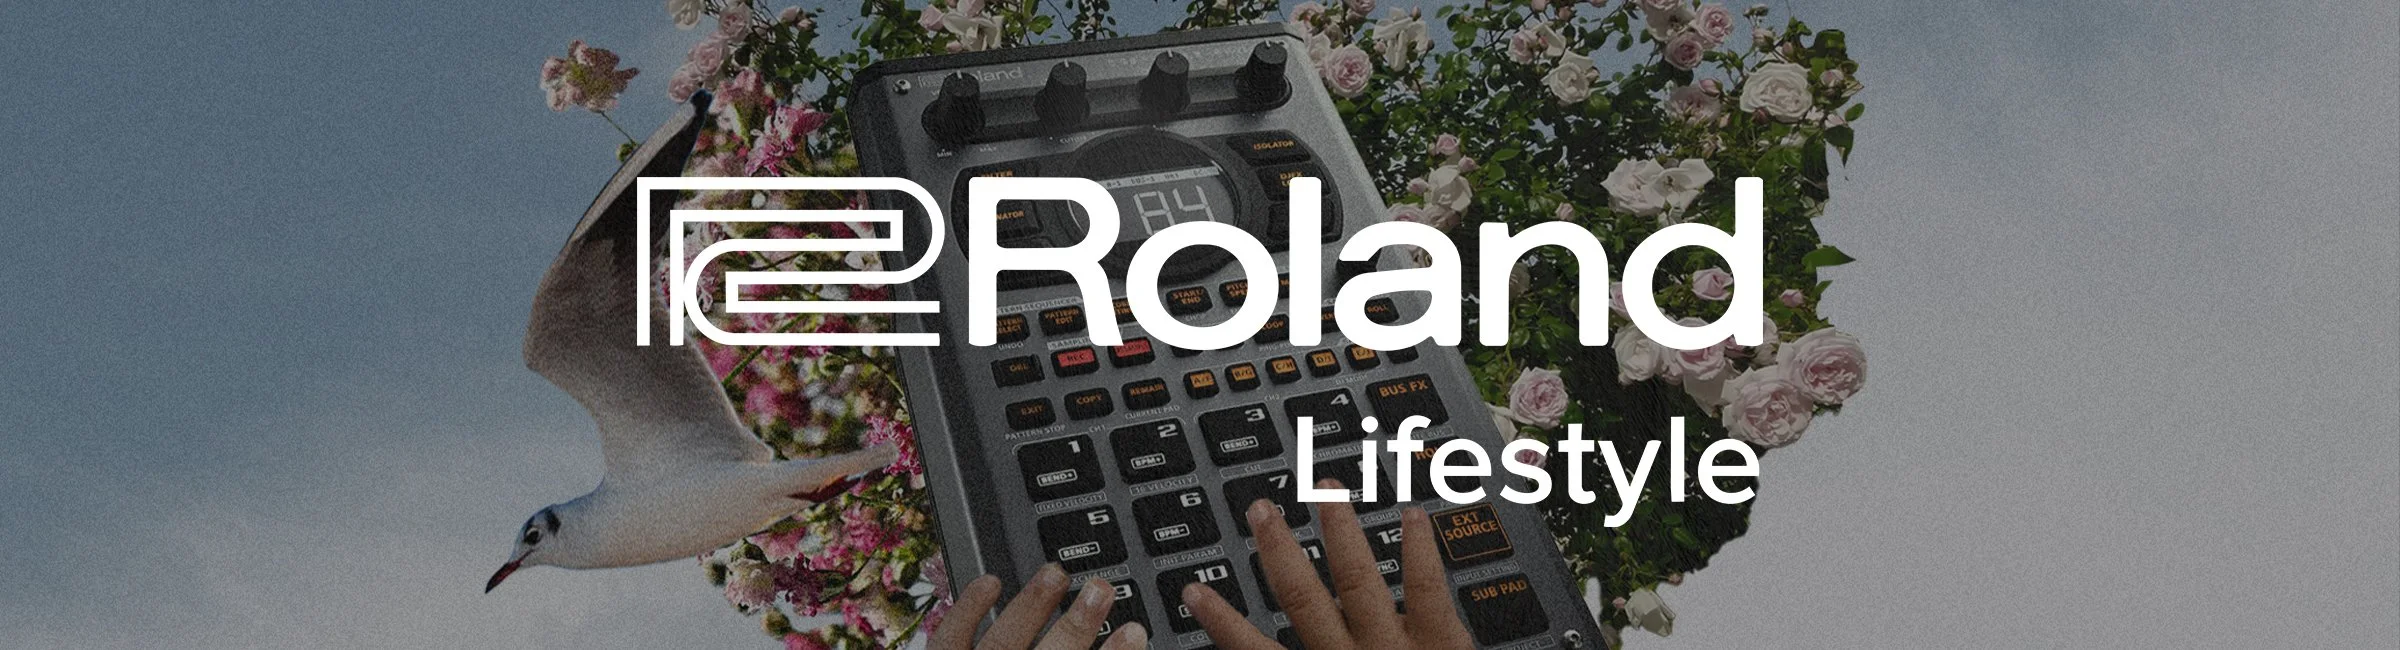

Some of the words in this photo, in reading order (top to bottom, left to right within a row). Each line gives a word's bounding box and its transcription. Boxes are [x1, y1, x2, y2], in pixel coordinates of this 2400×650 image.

[1253, 140, 1294, 150] ISOLATOR
[997, 209, 1025, 221] NATOR
[1181, 297, 1202, 305] END
[998, 341, 1024, 351] UNDO
[1067, 352, 1086, 362] REC
[1130, 383, 1164, 397] REMAIN
[1379, 384, 1407, 398] BUS
[1410, 380, 1429, 392] FX
[1076, 393, 1102, 405] COPY
[1330, 394, 1349, 406] 4
[1020, 404, 1043, 415] EXIT
[1125, 408, 1161, 420] CURRENT
[1163, 404, 1181, 414] PAD
[1245, 408, 1266, 422] 3
[1005, 428, 1043, 441] PATTERN
[1045, 424, 1066, 435] STOP
[1157, 423, 1179, 438] 2
[1068, 440, 1081, 454] 1
[1313, 445, 1360, 459] CHROMATI
[1148, 477, 1194, 491] VELOCITY
[1268, 474, 1288, 489] 7
[1065, 494, 1104, 507] VELOCITY
[1180, 492, 1202, 507] 6
[1087, 509, 1110, 526] 5
[1452, 511, 1479, 526] EXT
[1377, 527, 1403, 545] 12
[1445, 520, 1499, 541] SOURCE
[1063, 545, 1097, 558] BEND-
[1072, 567, 1119, 585] XCHANGE
[1194, 565, 1229, 584] 10
[1113, 584, 1133, 601] 9
[1471, 585, 1498, 601] SUB
[1500, 580, 1528, 595] PAD
